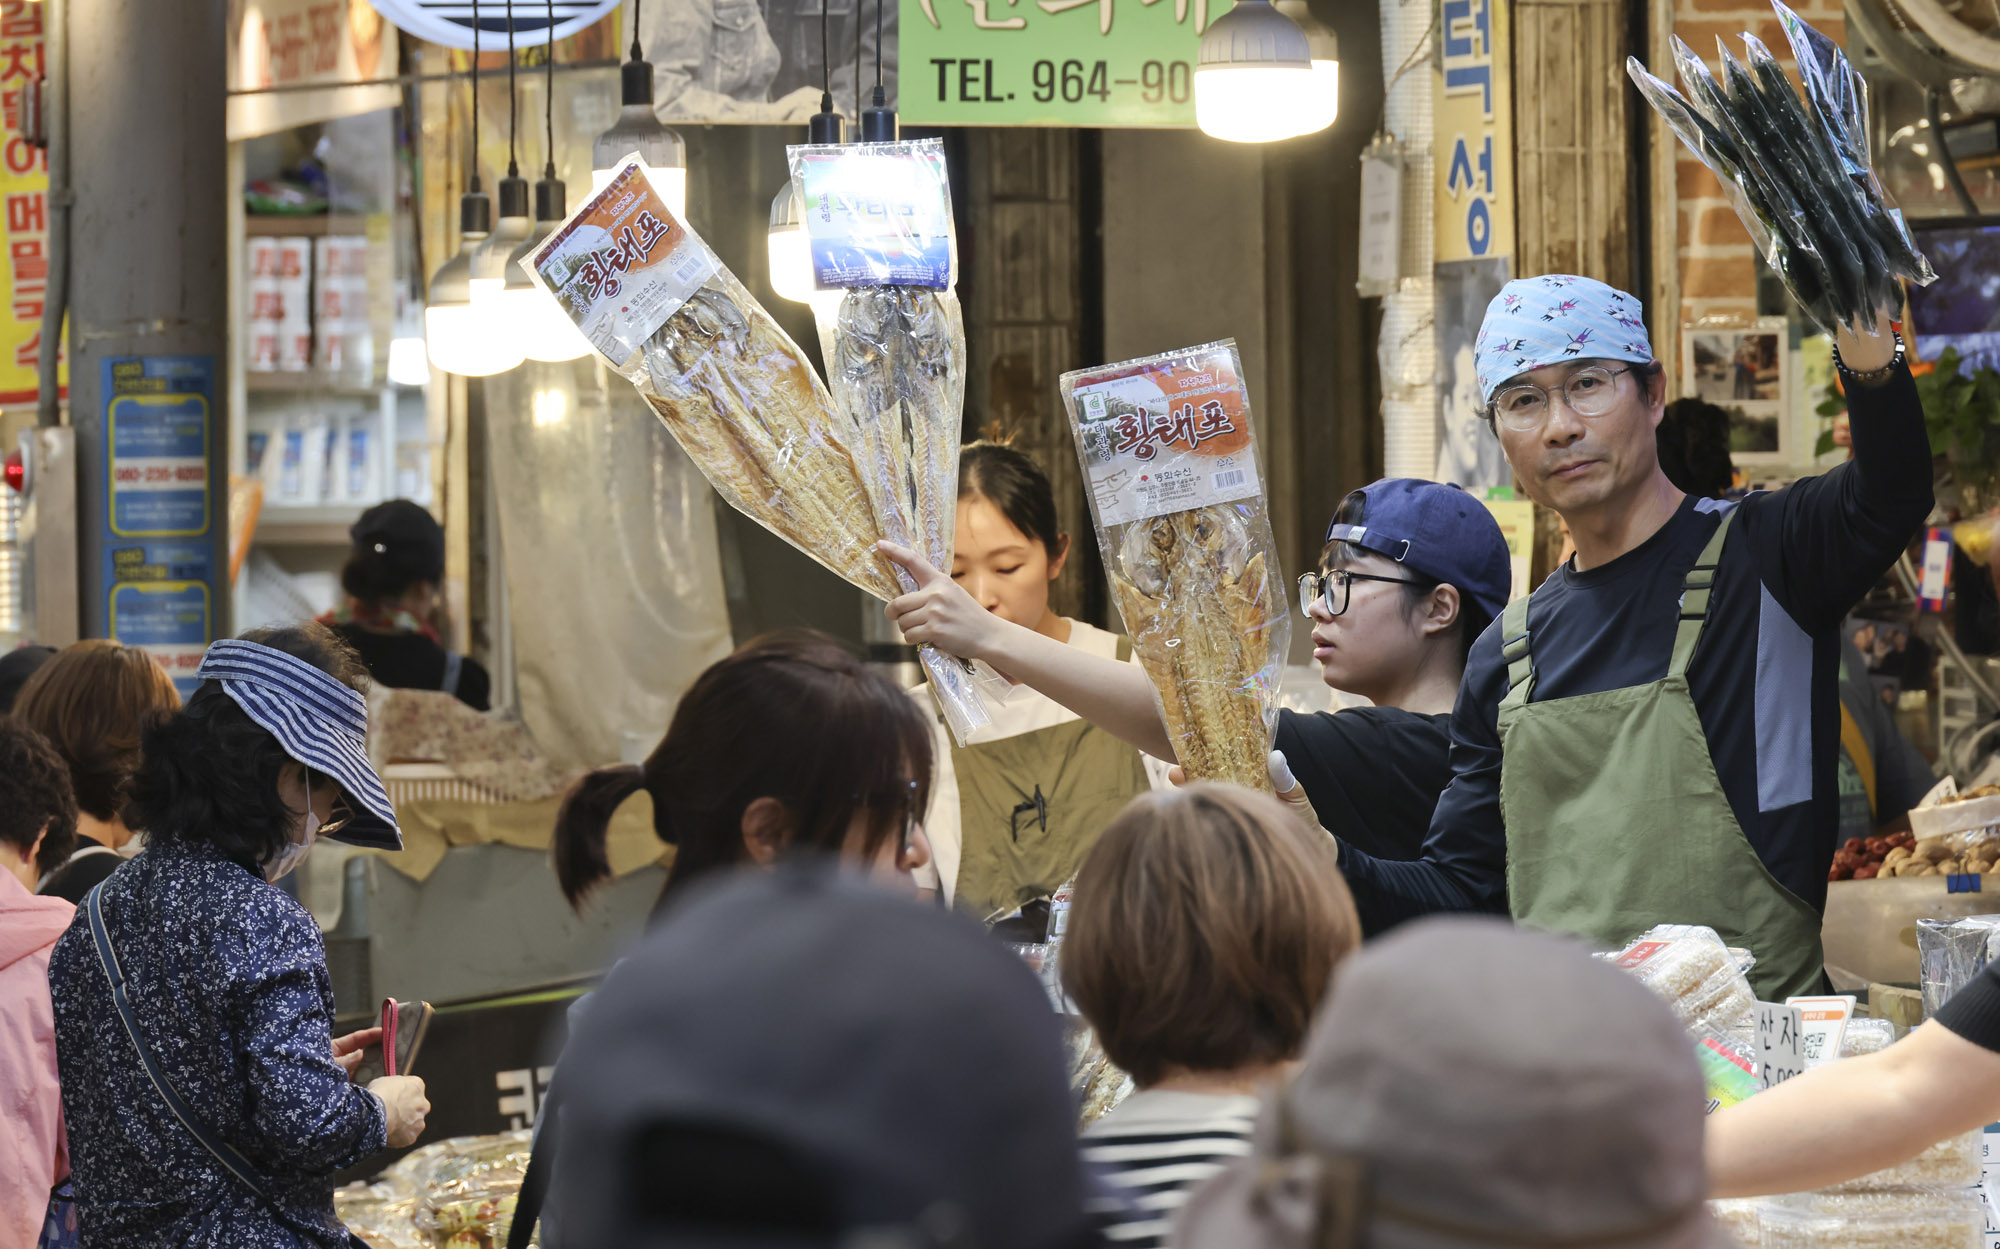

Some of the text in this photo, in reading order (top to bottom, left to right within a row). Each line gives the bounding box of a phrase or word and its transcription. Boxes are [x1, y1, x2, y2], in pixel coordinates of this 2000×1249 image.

[929, 58, 1015, 102] TEL.
[580, 209, 670, 300] 황태포
[1094, 421, 1111, 462] 대관령
[1113, 400, 1237, 461] 황태포
